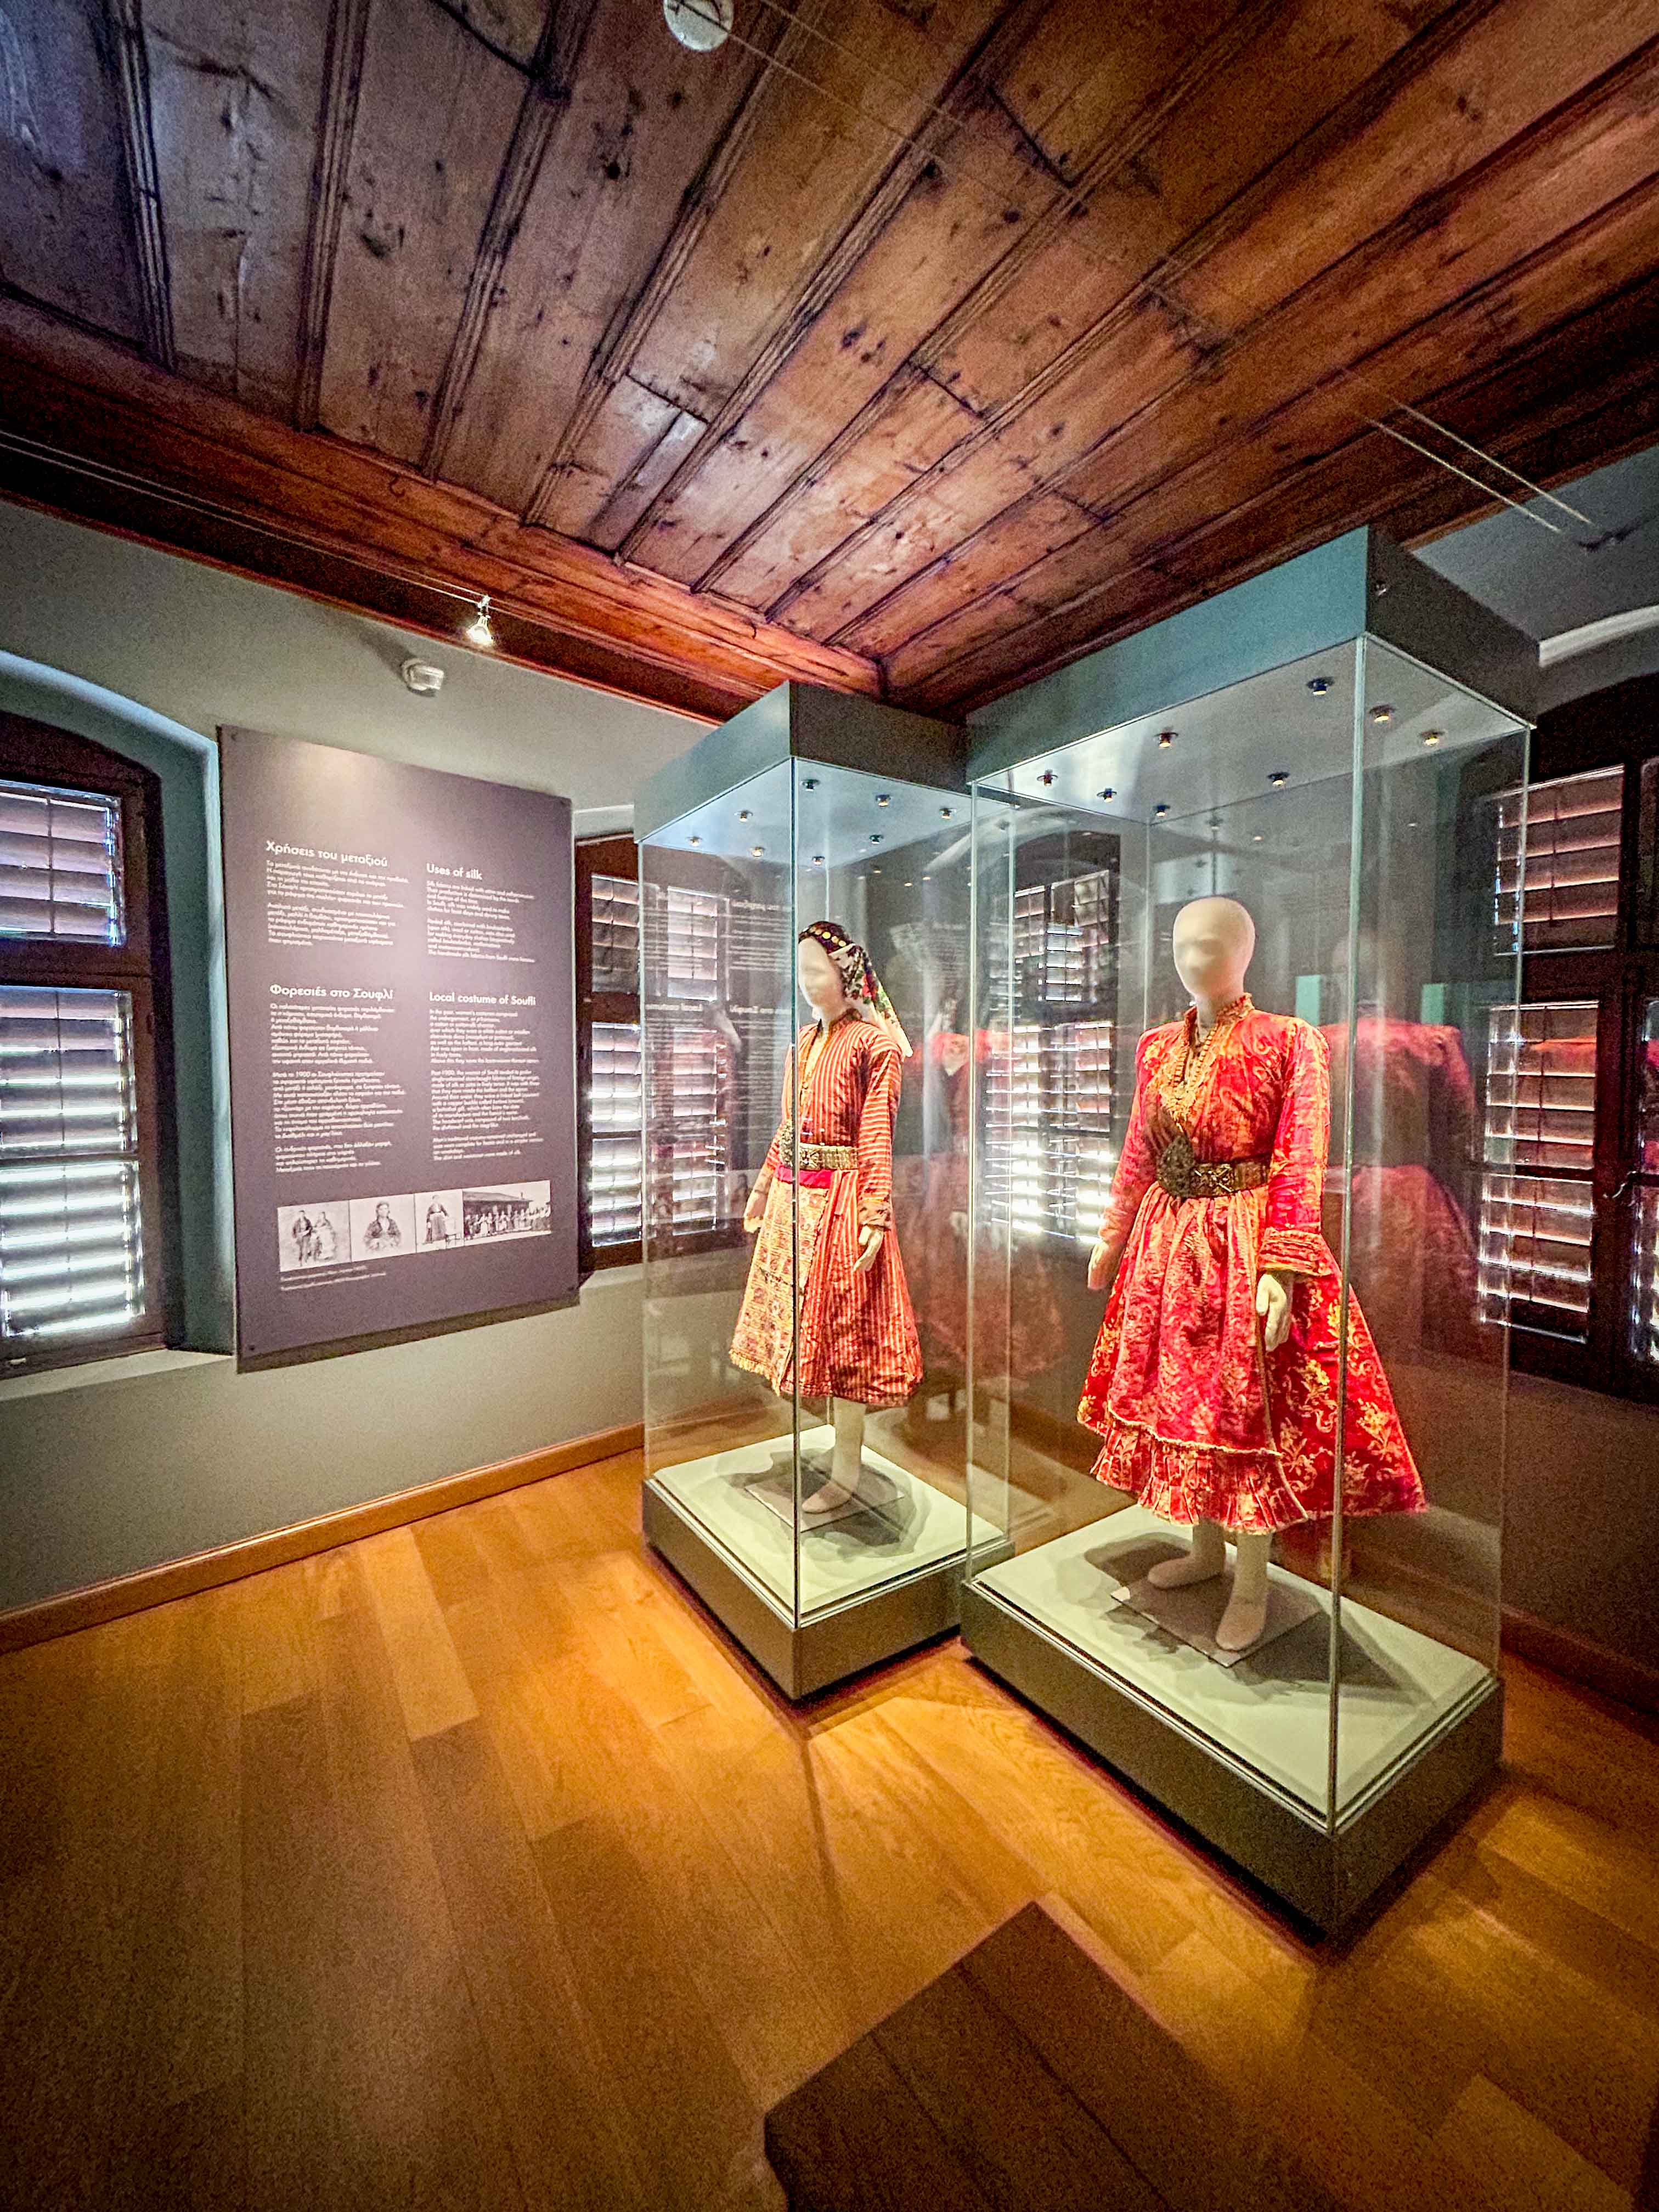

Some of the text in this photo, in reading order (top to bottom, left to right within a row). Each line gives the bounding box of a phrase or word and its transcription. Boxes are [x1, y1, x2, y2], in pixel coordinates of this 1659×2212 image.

[266, 840, 387, 866] Χρήσεις του μεταξιού
[427, 863, 482, 880] Uses of silk
[270, 984, 394, 1001] Φορεσιές στο Σουφλί
[430, 991, 536, 1006] Local costume of Soufli
